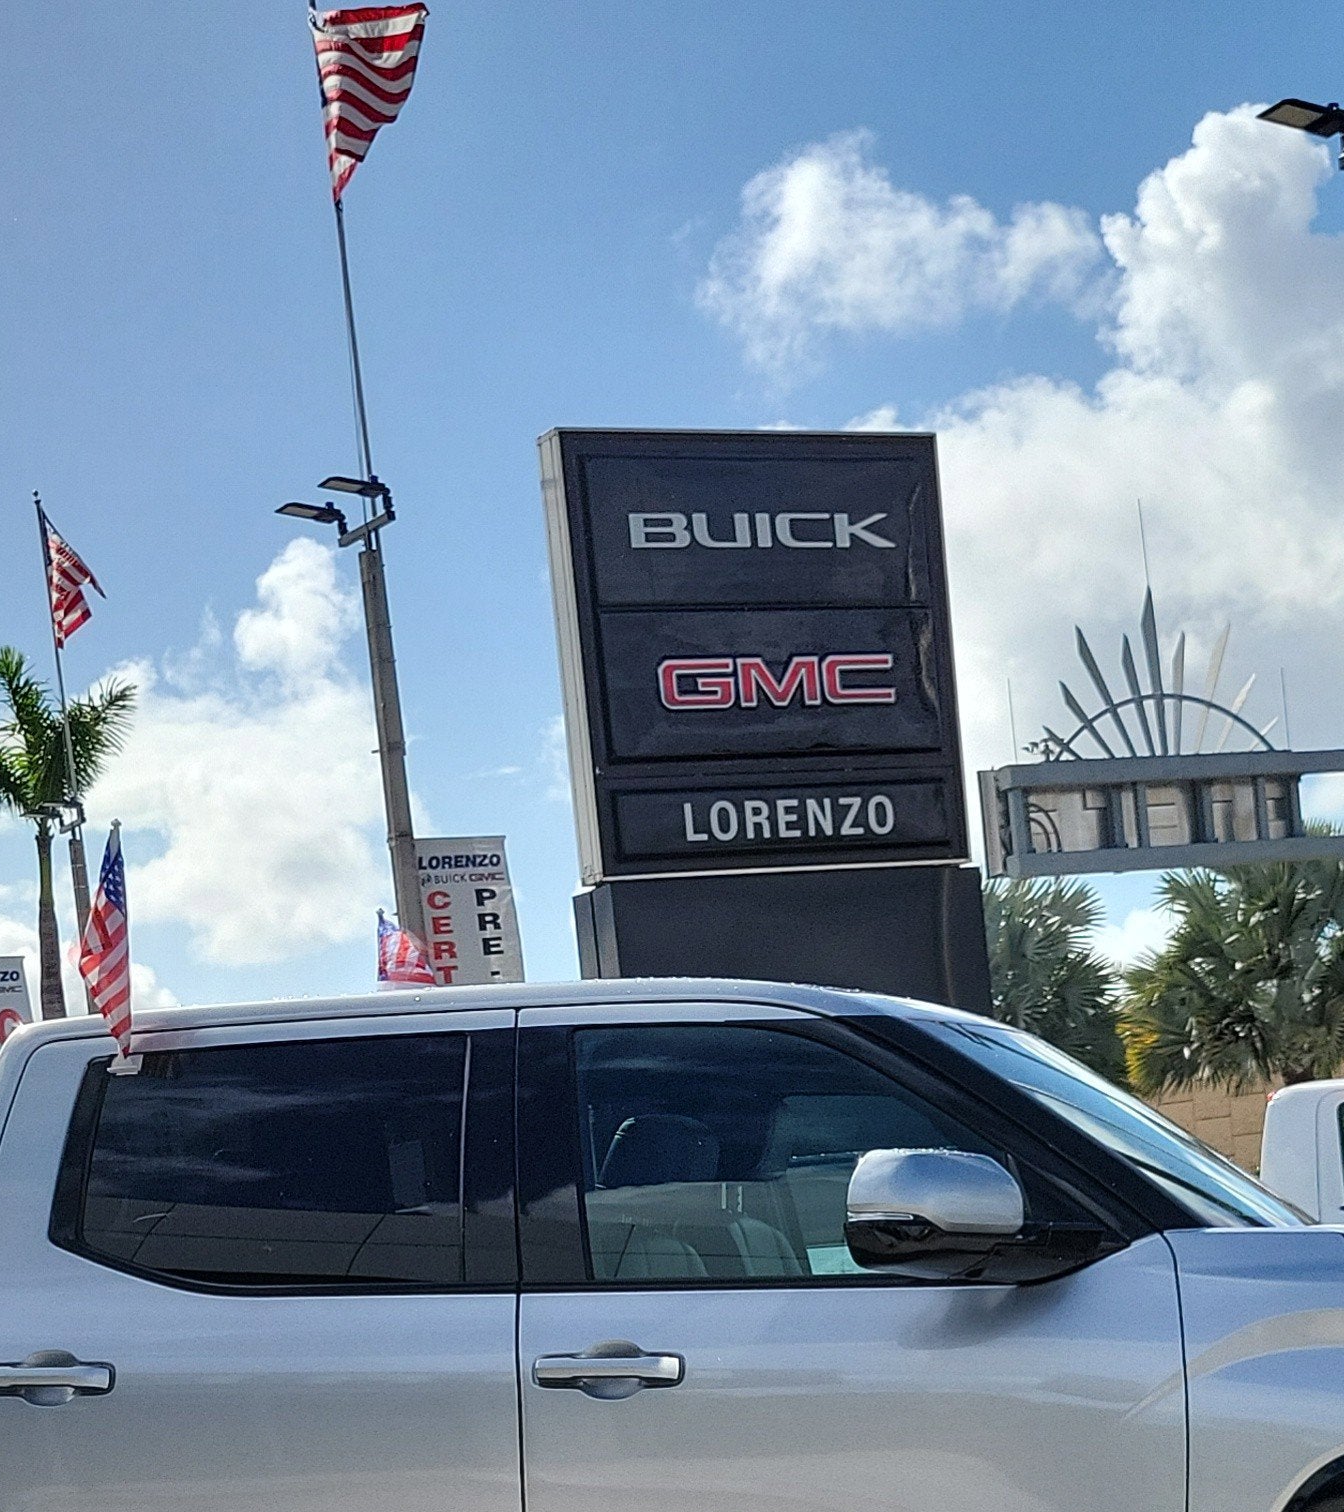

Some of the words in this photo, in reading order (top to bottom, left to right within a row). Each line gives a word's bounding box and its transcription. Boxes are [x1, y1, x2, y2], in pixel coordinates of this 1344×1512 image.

[628, 512, 897, 549] BUICK
[657, 653, 897, 710] GMC
[683, 794, 896, 842] LORENZO
[418, 854, 501, 871] LORENZO
[434, 874, 467, 884] BUICK
[469, 872, 505, 882] GMC
